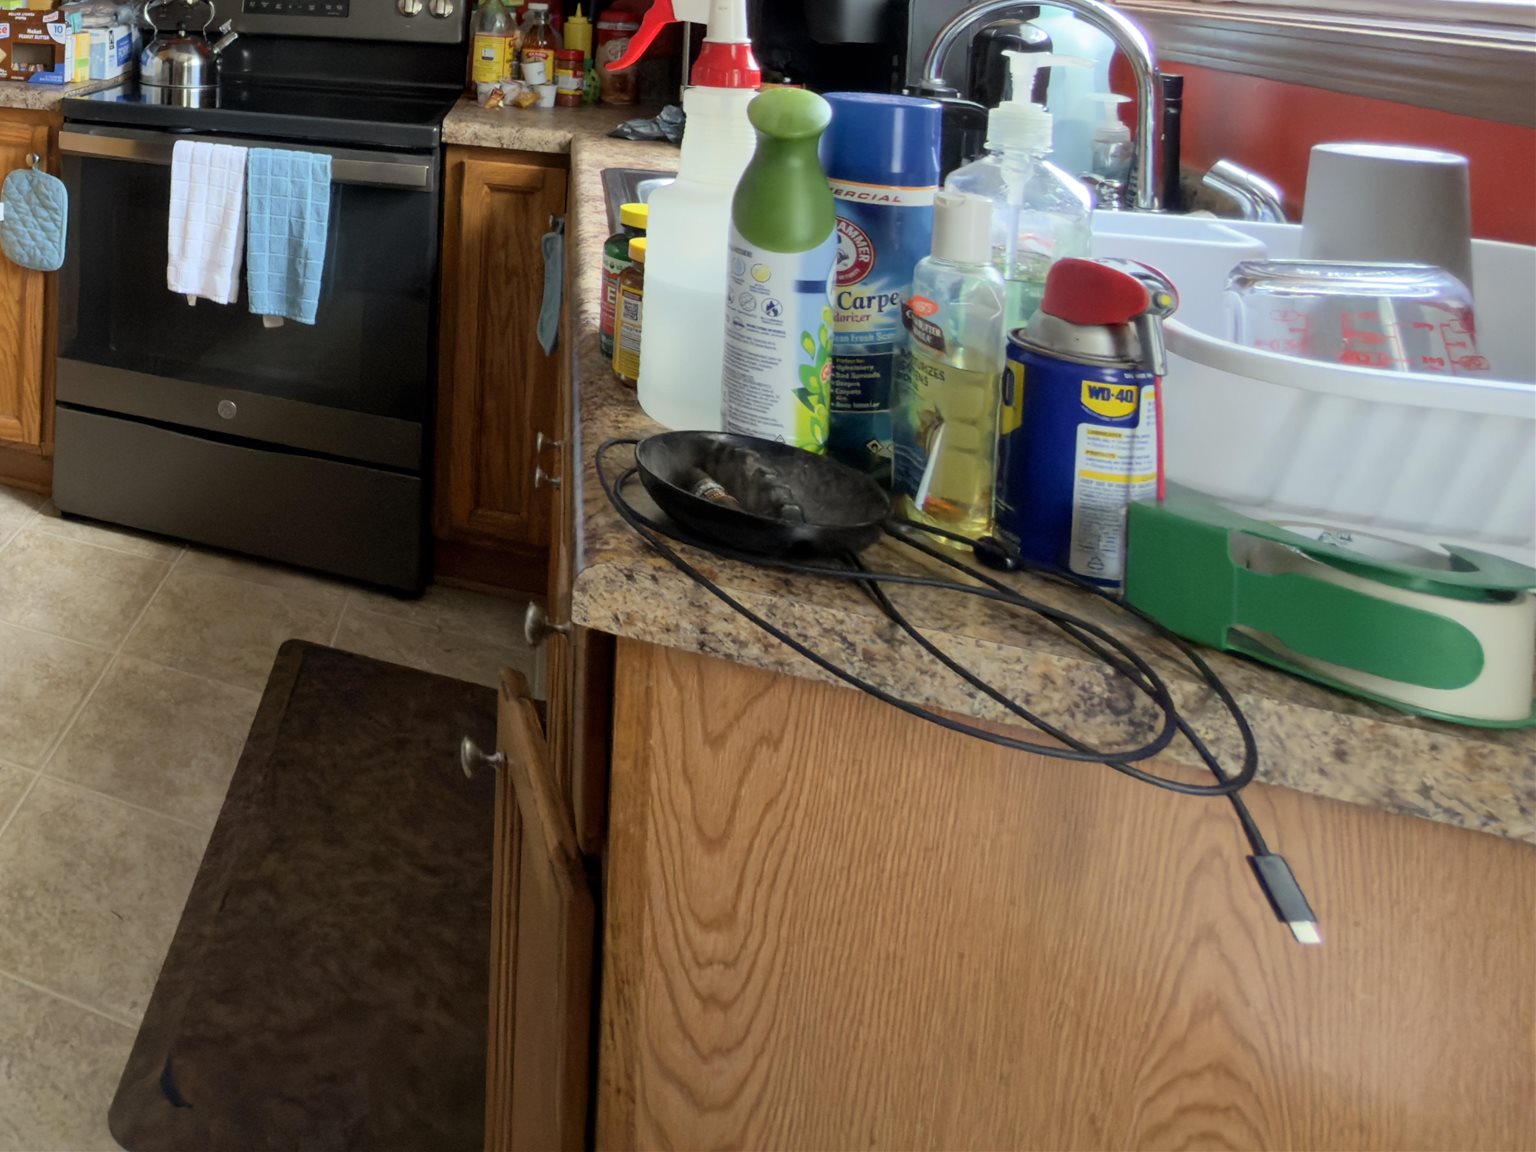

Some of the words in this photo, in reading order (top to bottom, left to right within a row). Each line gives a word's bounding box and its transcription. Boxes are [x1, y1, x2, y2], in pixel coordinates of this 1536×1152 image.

[54, 25, 63, 34] 10
[833, 188, 901, 203] ERCIAL
[836, 220, 871, 263] AMMER
[837, 291, 900, 313] Carpe
[834, 311, 872, 324] dorizer
[1087, 384, 1135, 404] WD-40
